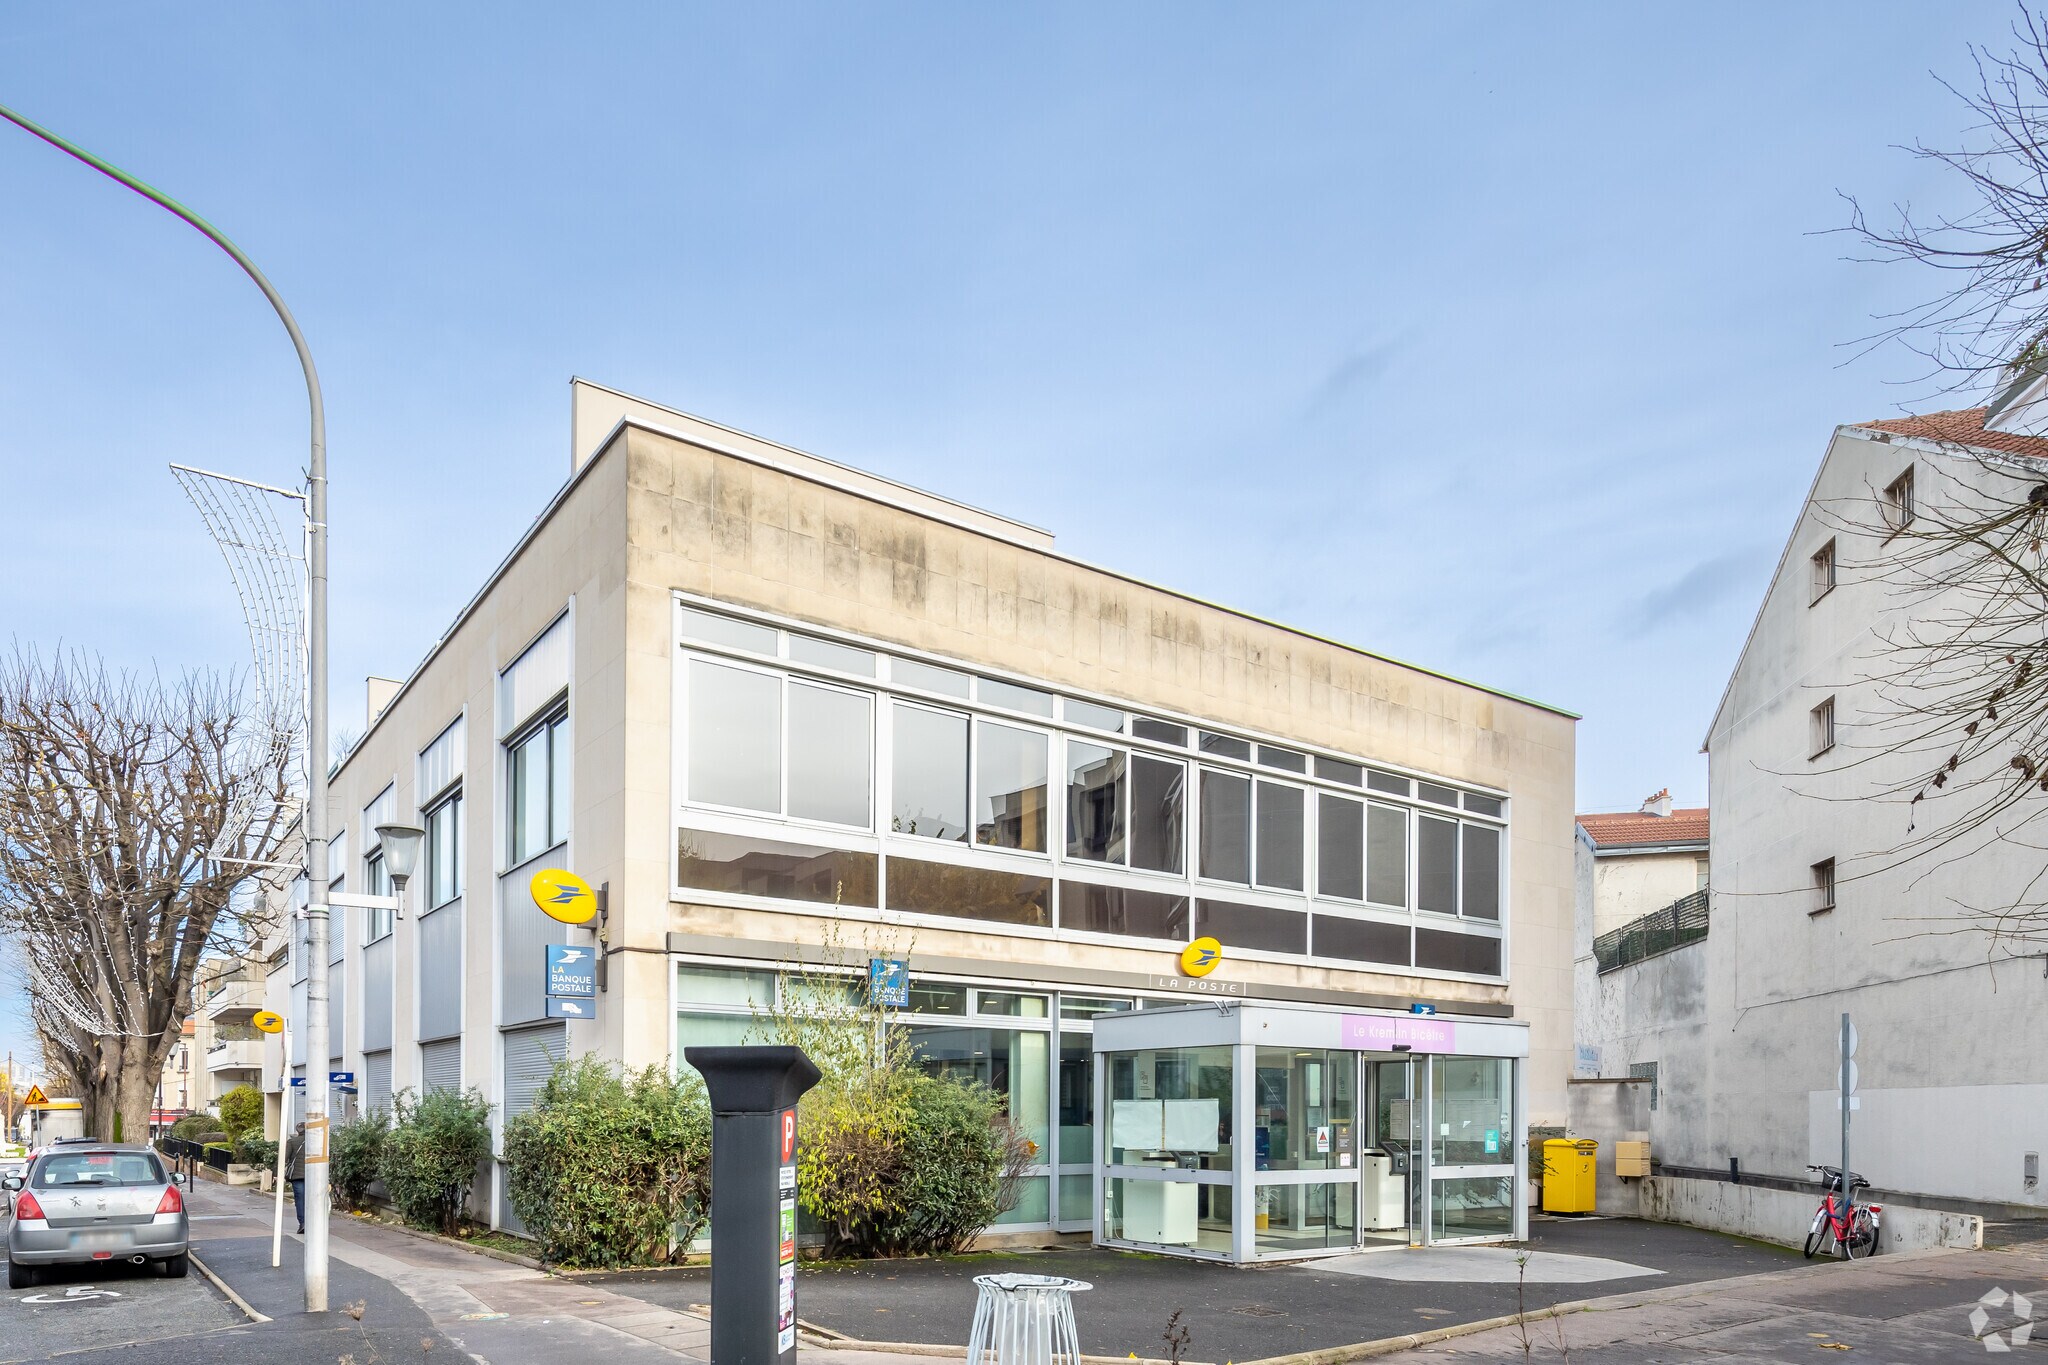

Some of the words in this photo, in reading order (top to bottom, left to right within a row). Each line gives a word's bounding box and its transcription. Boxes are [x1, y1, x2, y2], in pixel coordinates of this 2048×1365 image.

[552, 965, 564, 974] LA
[552, 974, 592, 985] BANQUE
[1159, 978, 1178, 988] LA
[1188, 980, 1237, 993] POSTE
[552, 983, 592, 993] POSTALE
[1353, 1024, 1365, 1037] Le
[1369, 1025, 1408, 1040] Kremlin
[1411, 1027, 1445, 1041] Bicêtre
[785, 1115, 794, 1153] P
